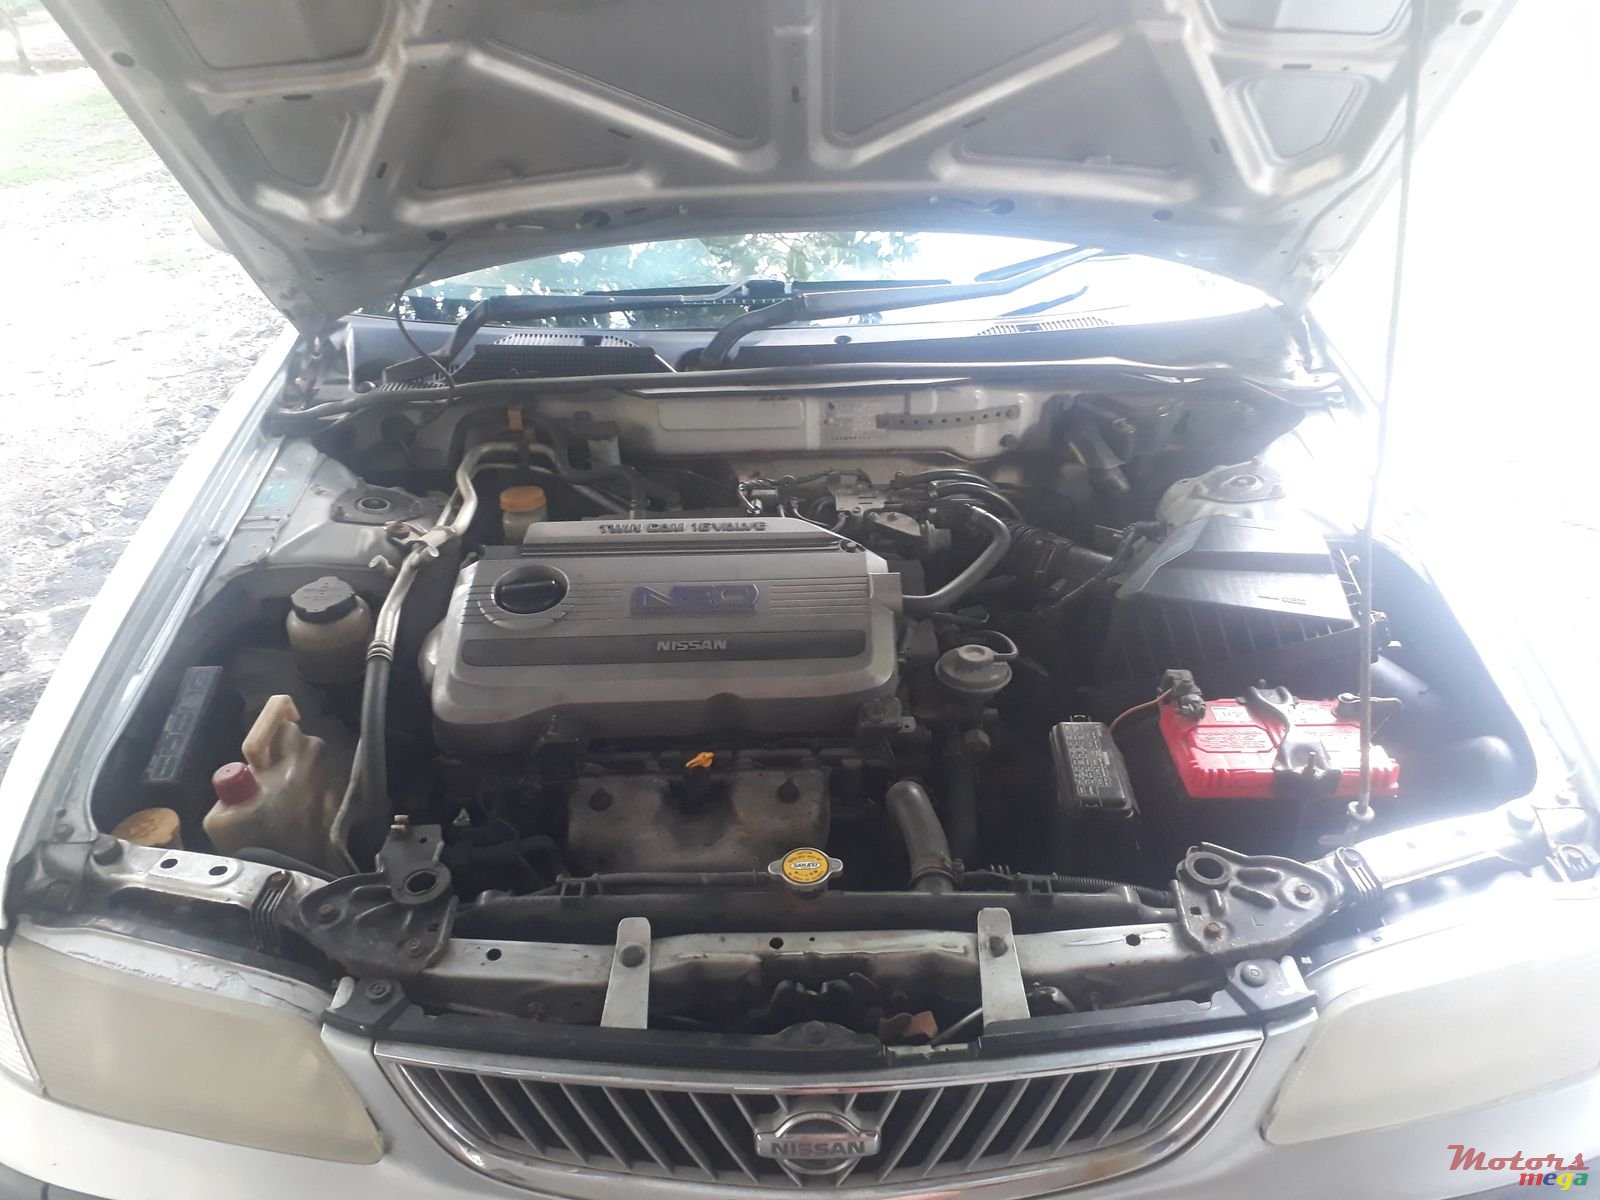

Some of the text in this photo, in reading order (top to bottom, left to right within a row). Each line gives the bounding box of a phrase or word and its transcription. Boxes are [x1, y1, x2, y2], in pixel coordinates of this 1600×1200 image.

[599, 523, 642, 535] TWIN
[647, 522, 685, 533] CAM
[656, 639, 728, 651] NISSAN
[771, 1141, 865, 1155] NISSAN
